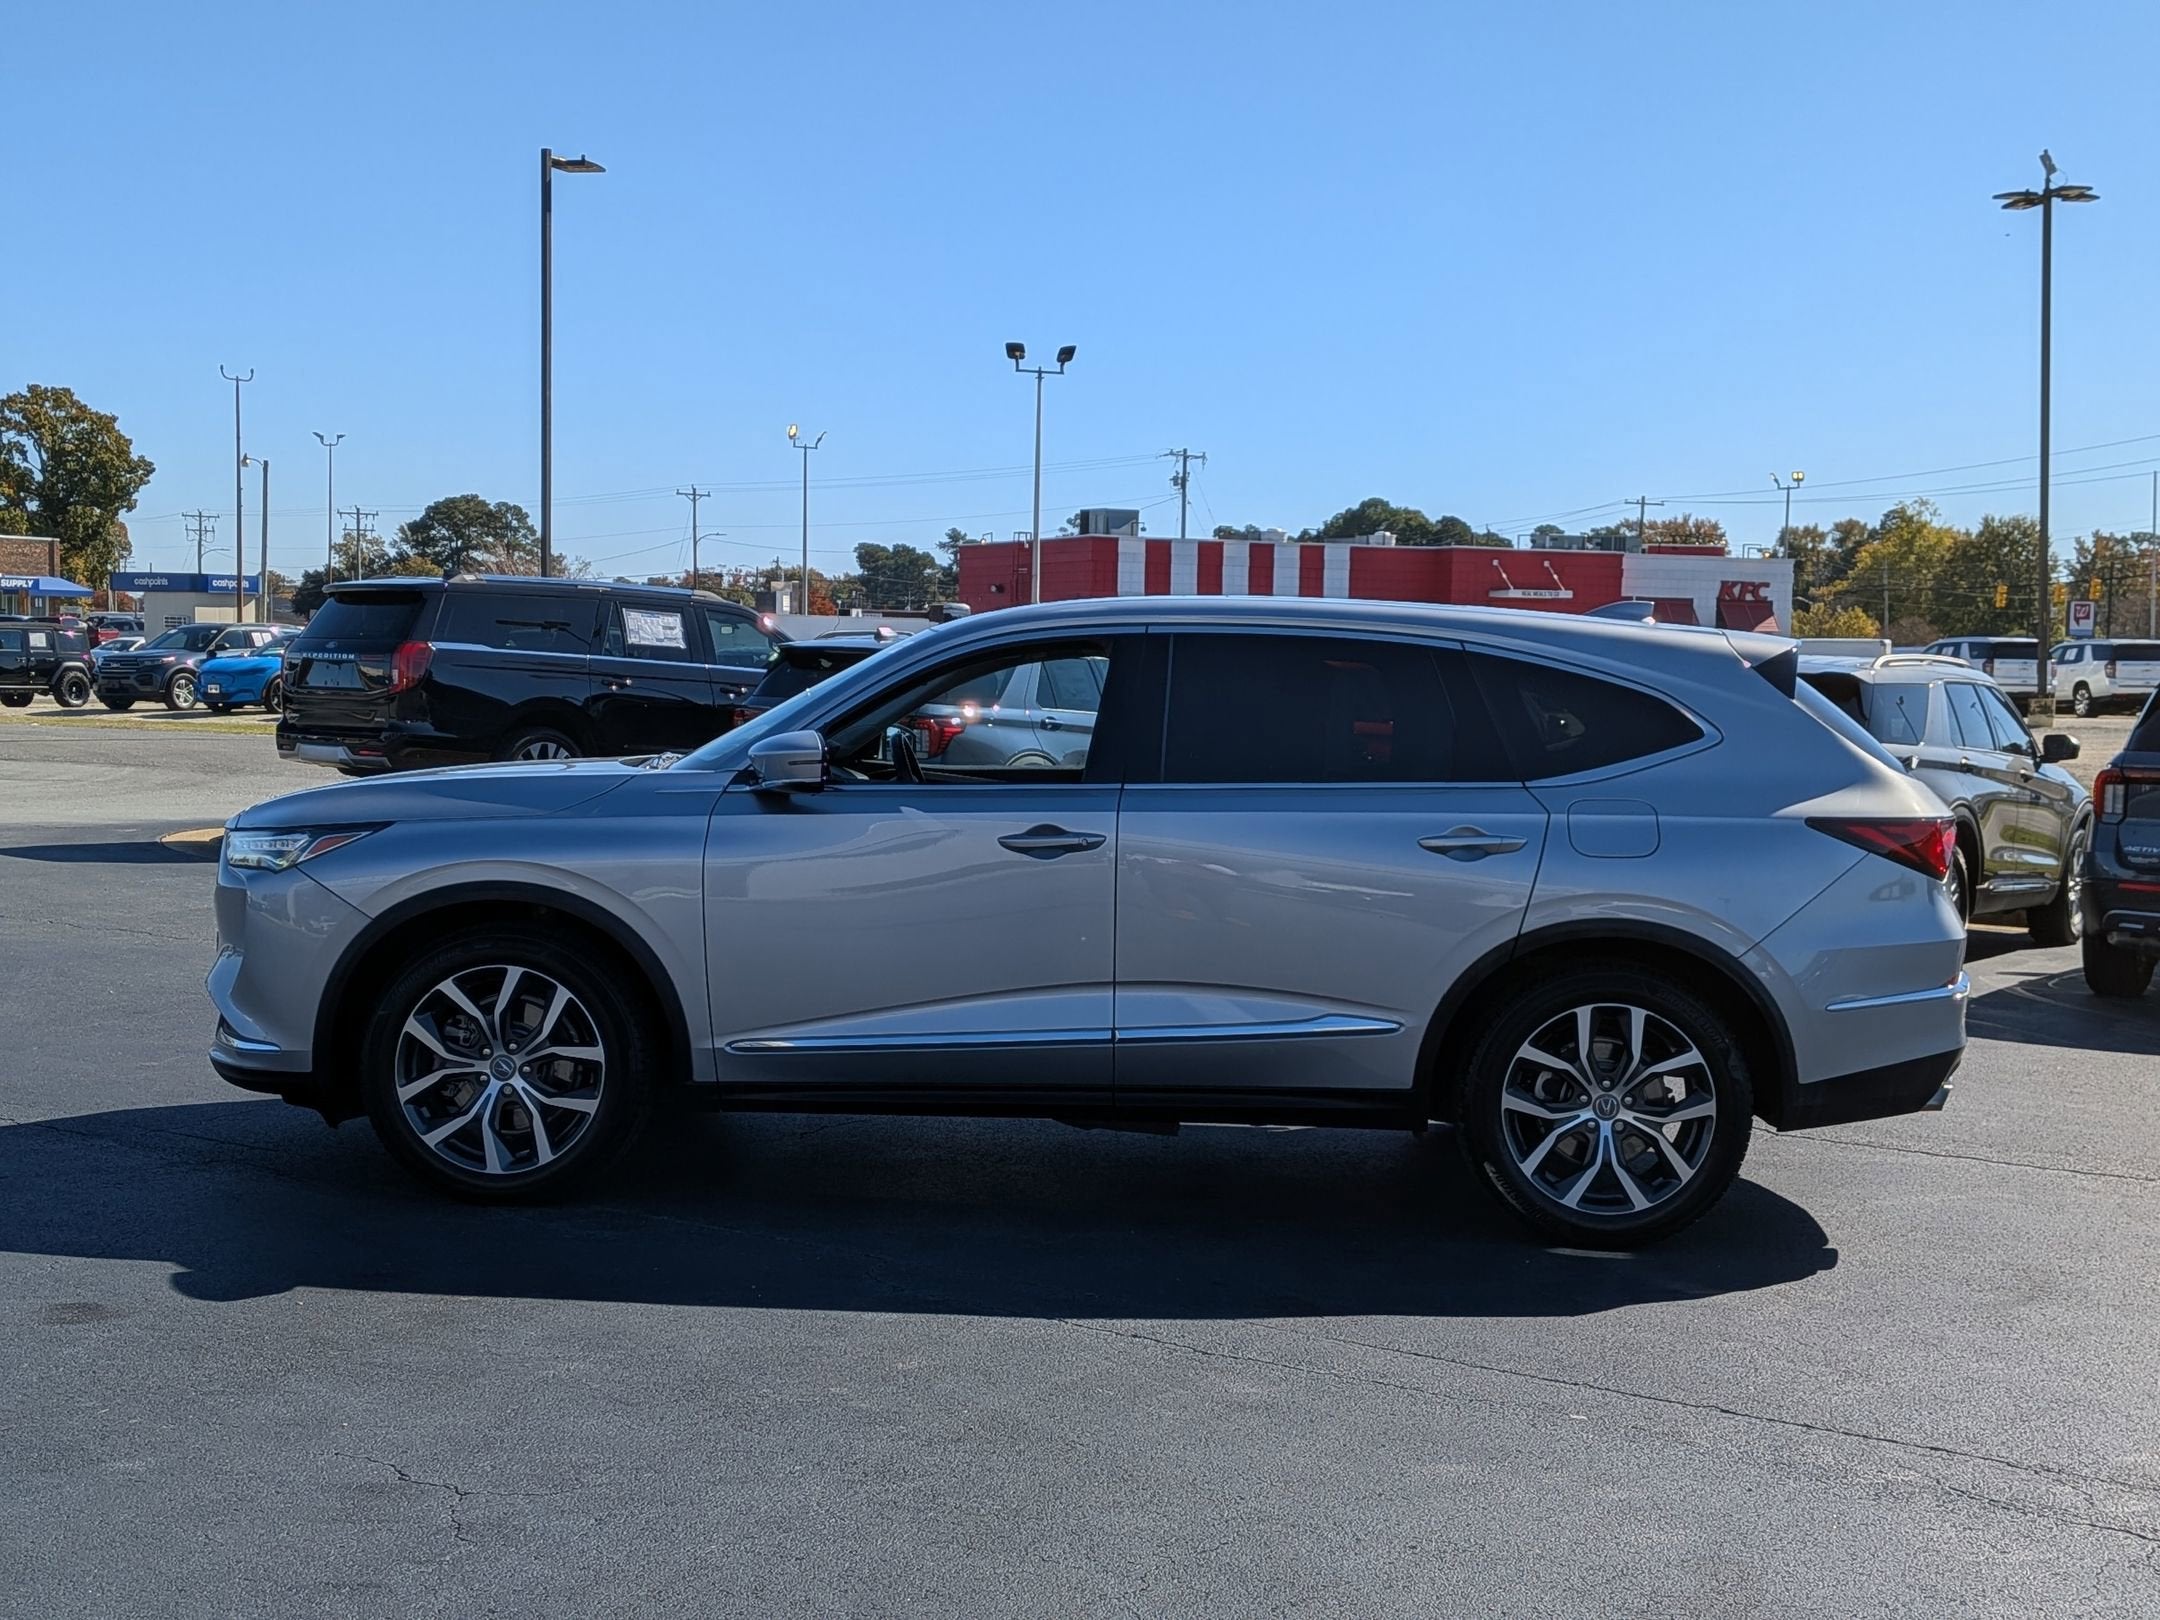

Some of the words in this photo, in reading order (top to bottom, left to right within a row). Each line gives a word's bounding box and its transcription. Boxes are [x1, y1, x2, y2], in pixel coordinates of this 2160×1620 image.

[1, 579, 34, 588] SUPPLY
[134, 577, 168, 588] cashpoints
[1718, 580, 1771, 601] KFC
